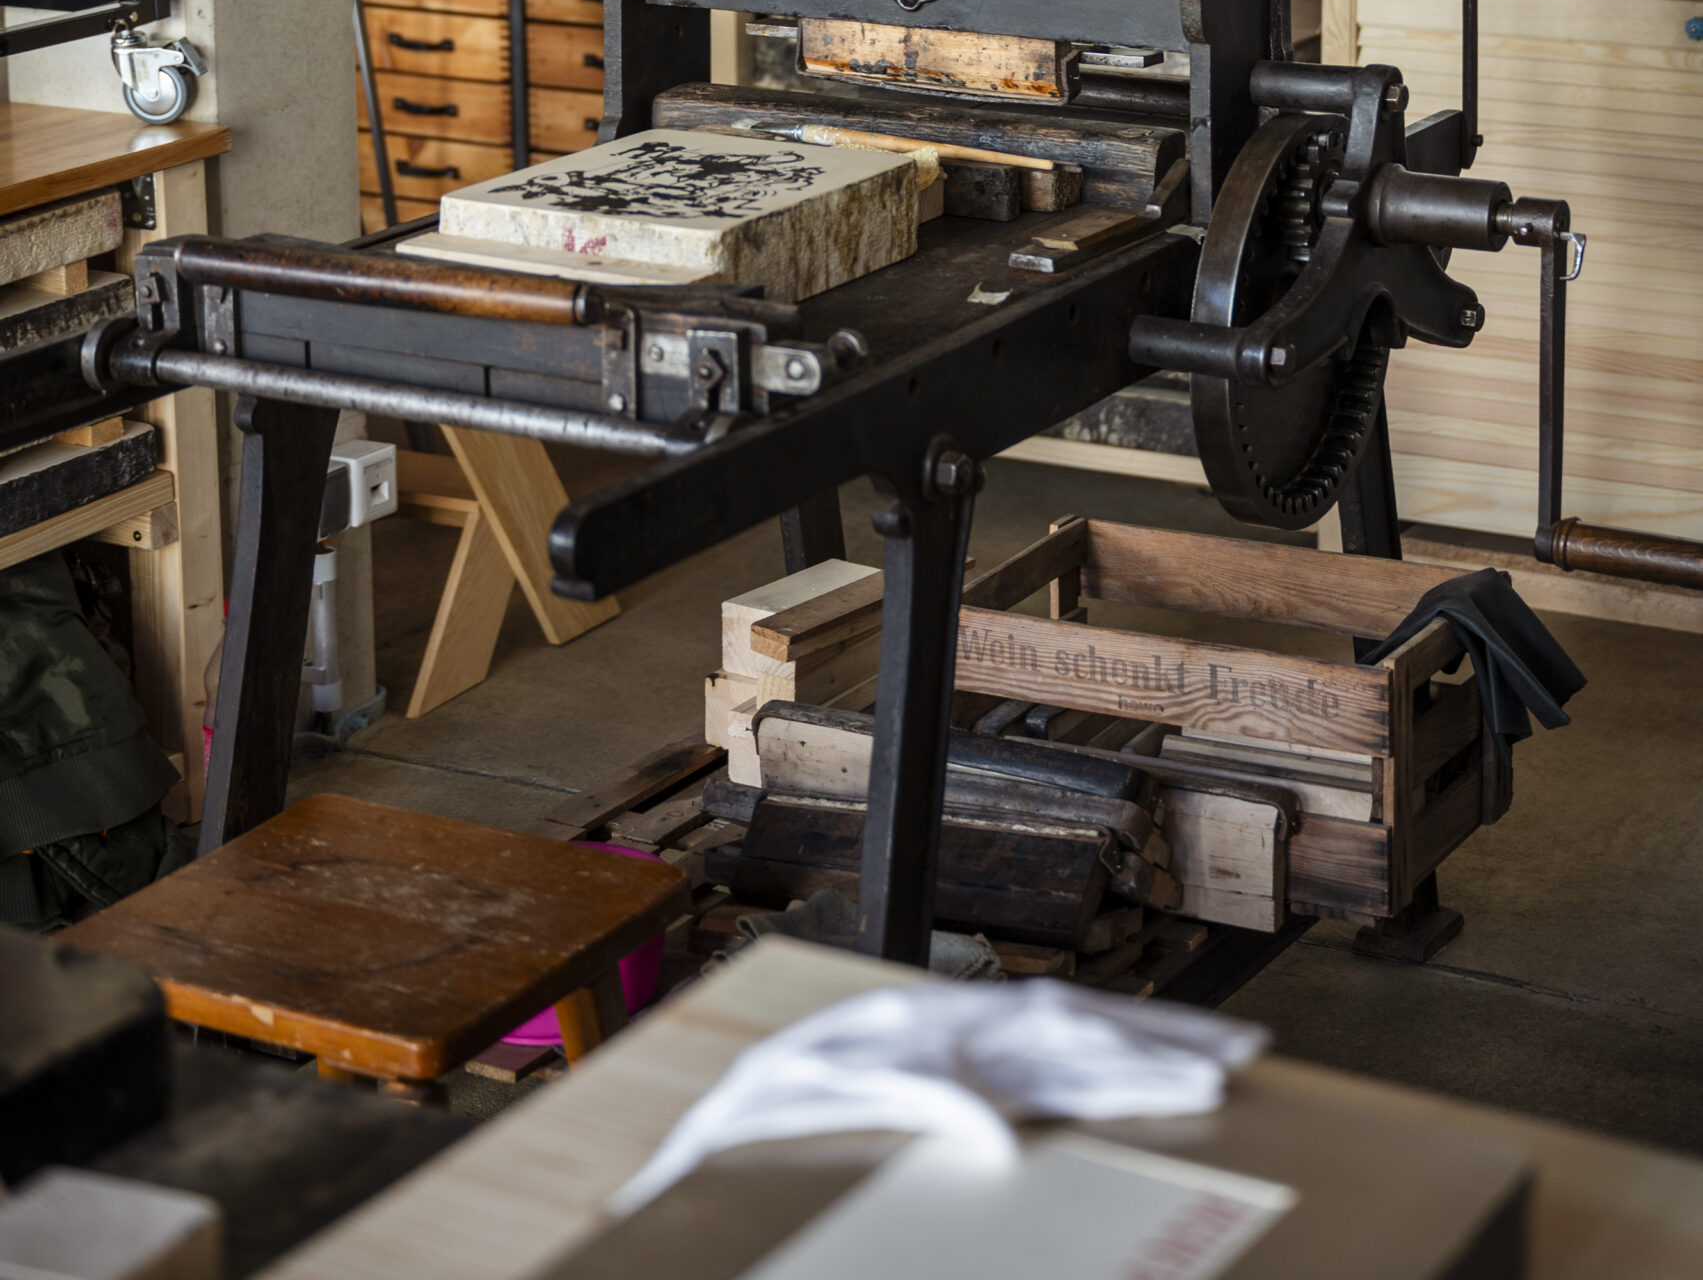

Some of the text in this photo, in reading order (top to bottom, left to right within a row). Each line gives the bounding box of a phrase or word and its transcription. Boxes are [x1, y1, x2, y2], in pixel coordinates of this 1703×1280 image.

[957, 624, 1340, 720] Wein schenkt Freude
